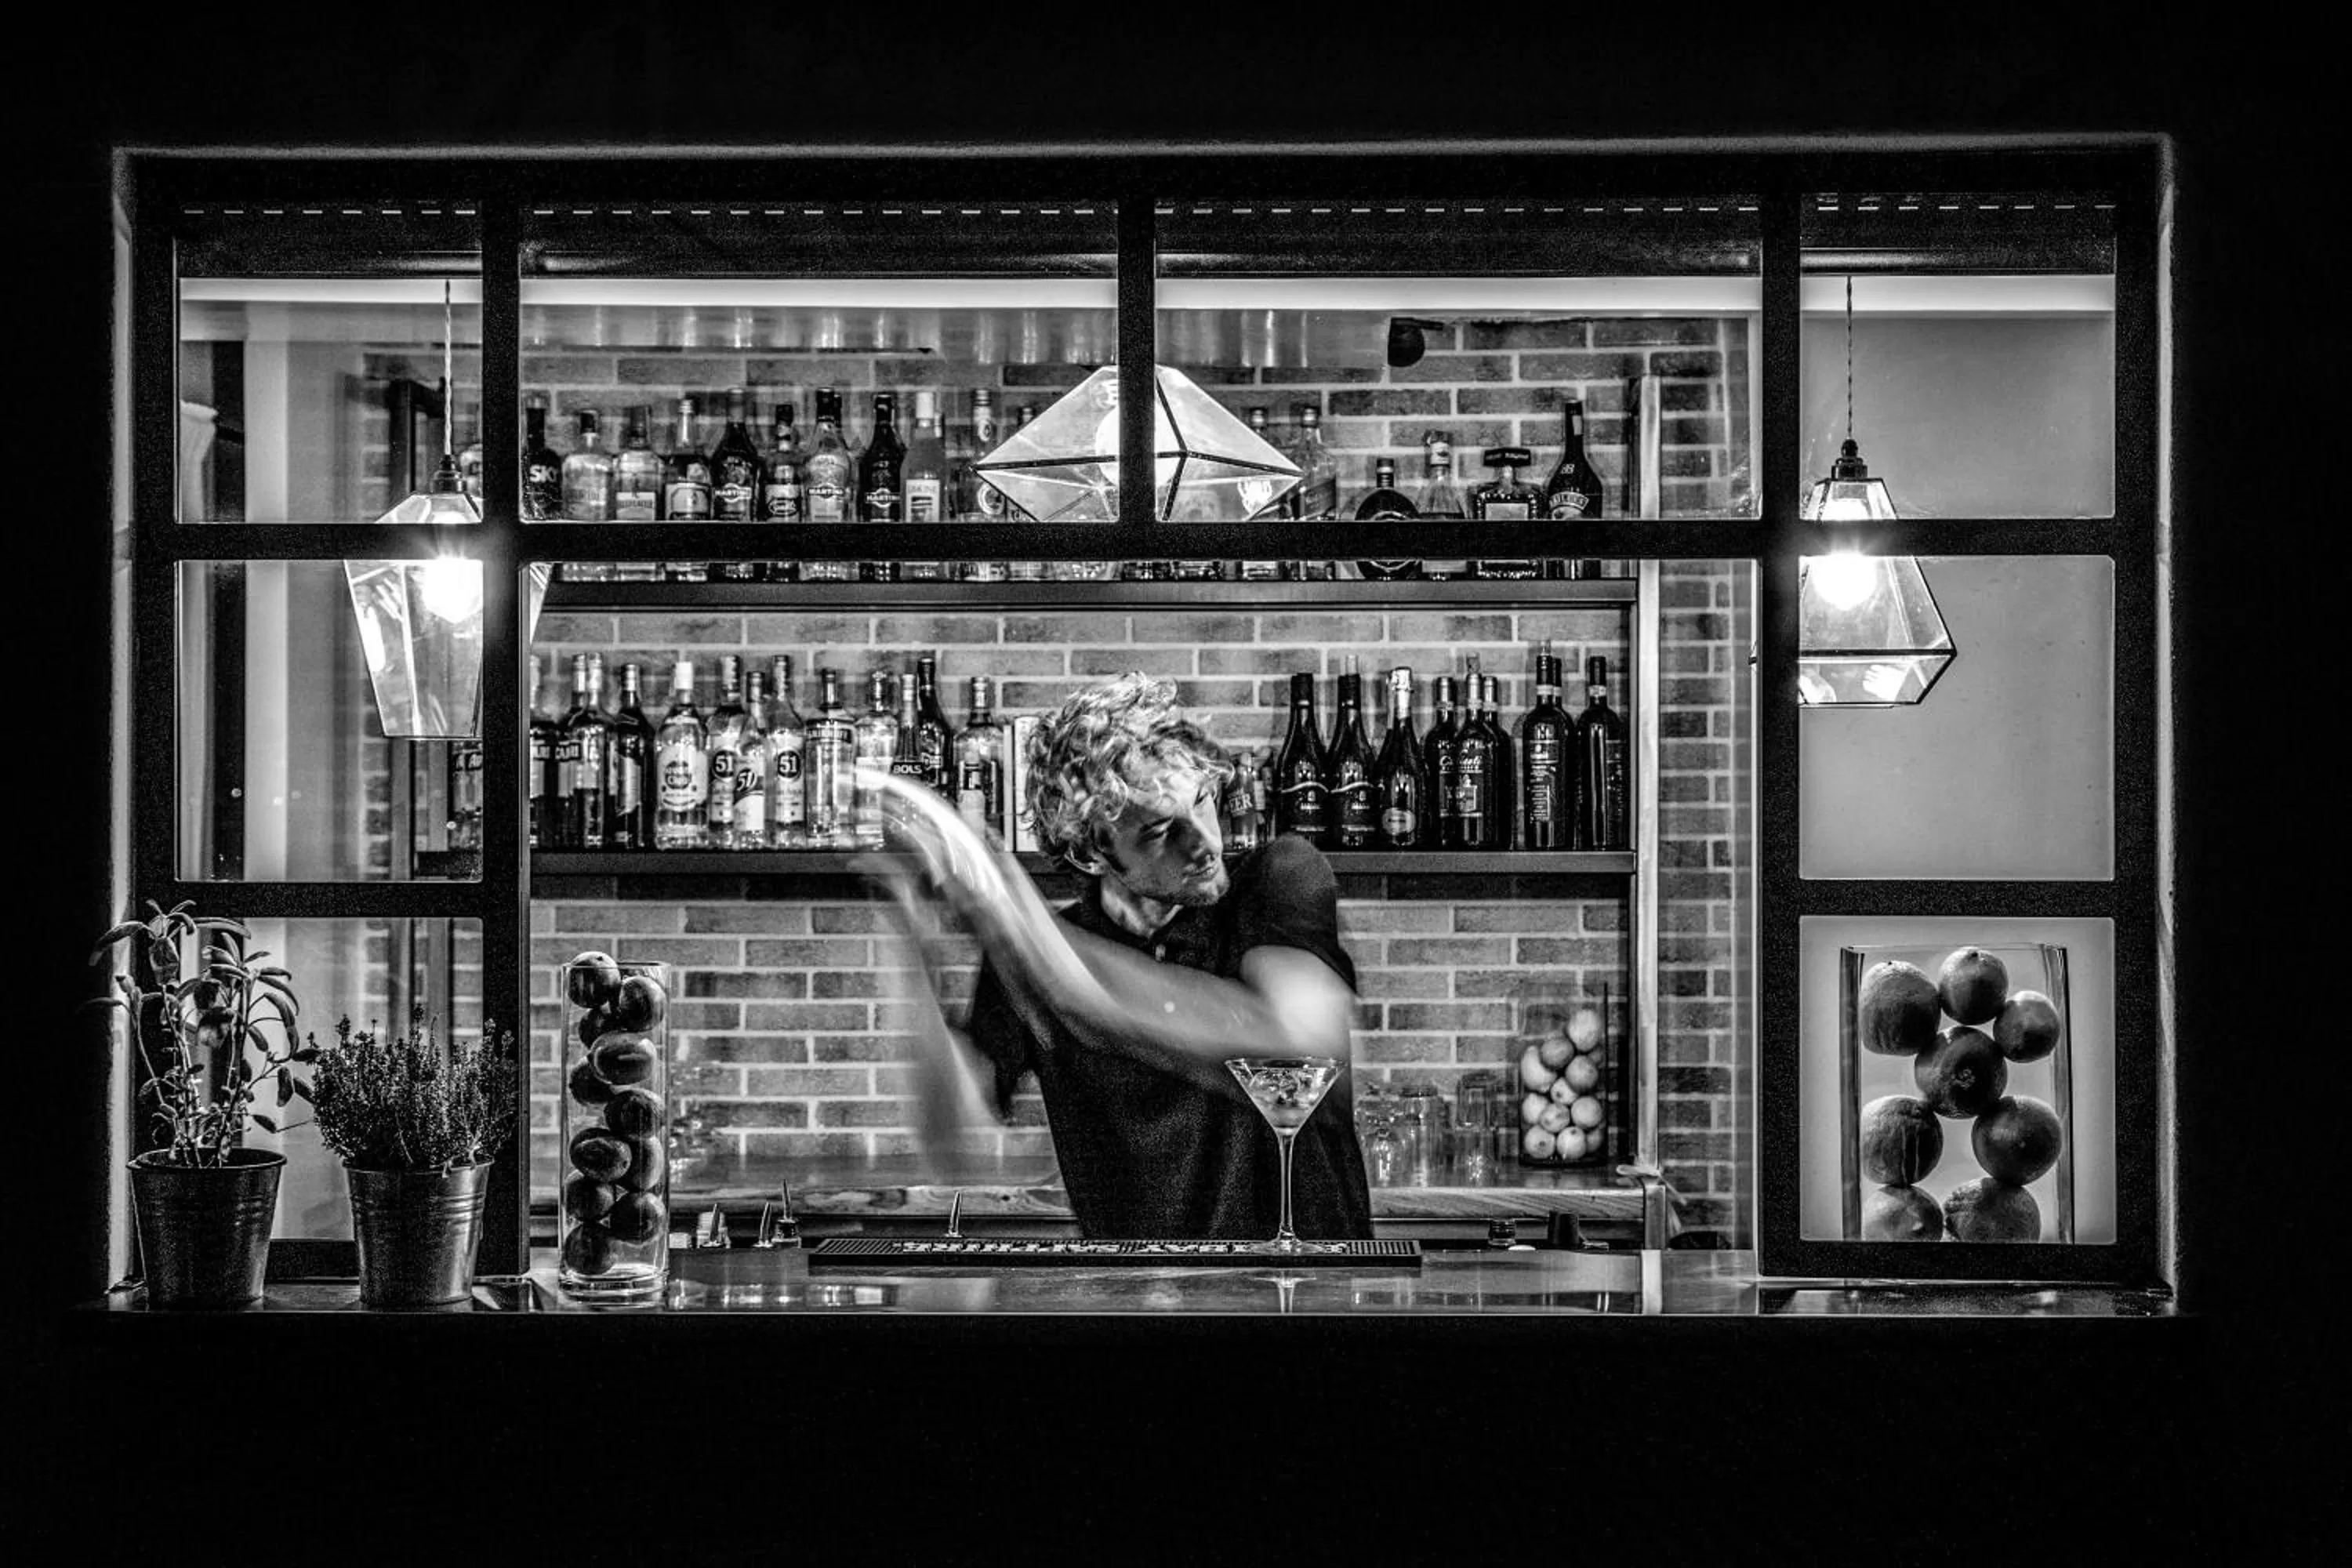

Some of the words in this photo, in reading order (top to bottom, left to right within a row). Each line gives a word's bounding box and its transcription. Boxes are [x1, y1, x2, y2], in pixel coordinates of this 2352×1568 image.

[713, 488, 750, 497] MARTINI
[808, 487, 844, 495] MARTINI
[866, 494, 901, 503] MARTINI
[716, 755, 733, 772] 51
[779, 756, 797, 773] 51
[893, 764, 923, 775] BOLS
[735, 771, 753, 792] 51
[902, 1243, 1119, 1253] SAPPHIRE
[1134, 1243, 1345, 1254] BBAY
